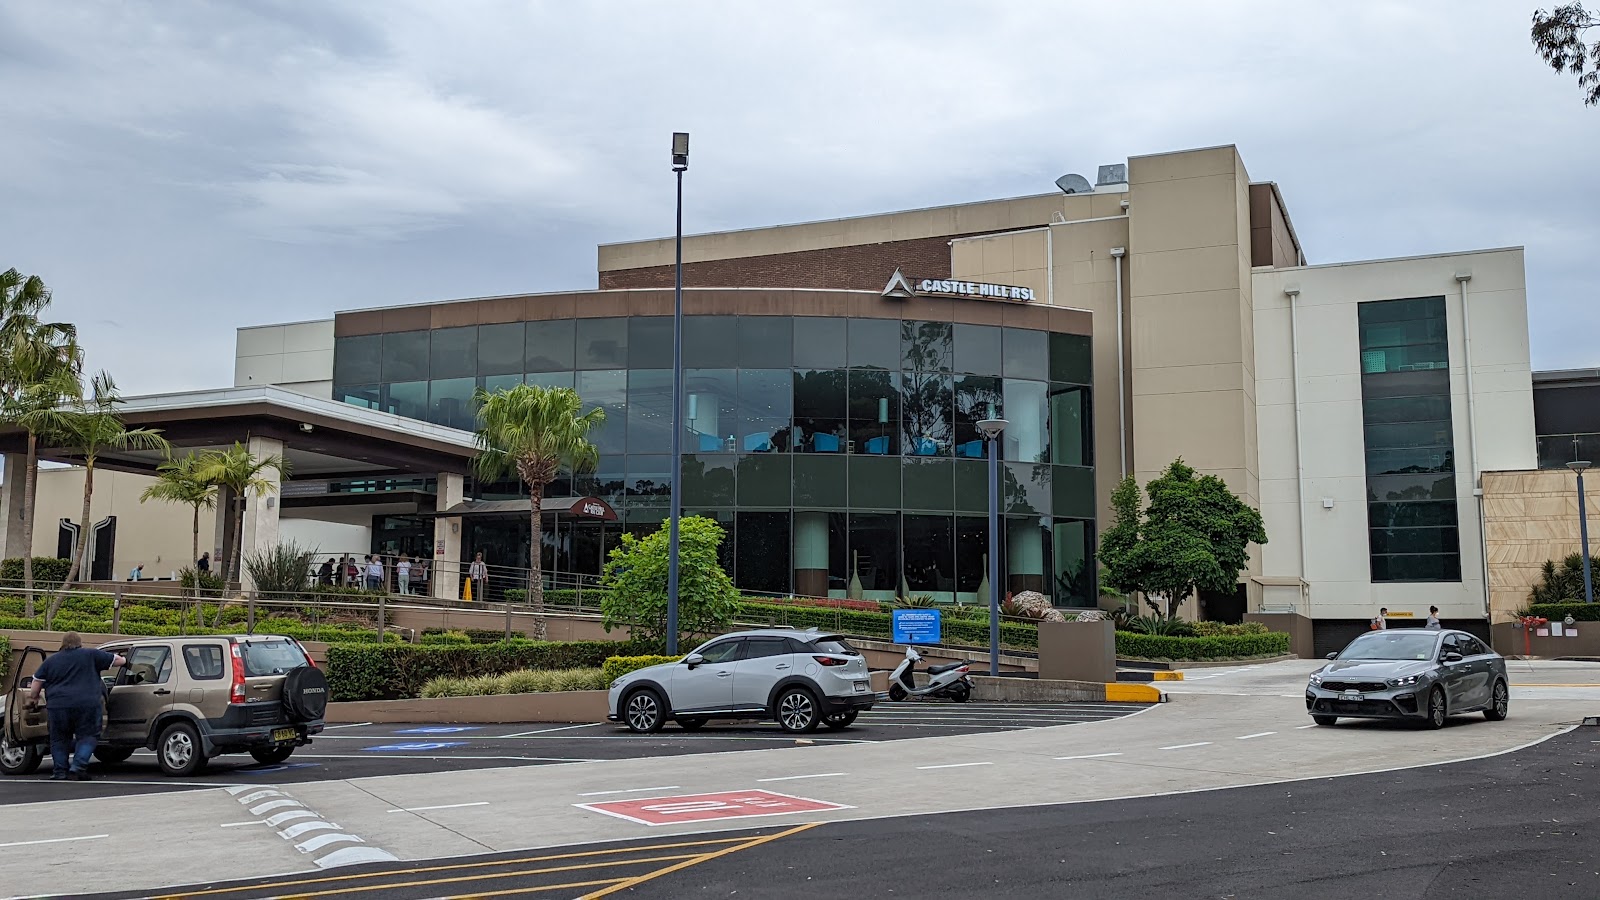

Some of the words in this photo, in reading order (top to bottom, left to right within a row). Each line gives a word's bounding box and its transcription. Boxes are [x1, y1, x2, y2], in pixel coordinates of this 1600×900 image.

[921, 279, 975, 294] CASTLE
[979, 283, 1008, 297] HILL
[1010, 286, 1037, 300] RSL
